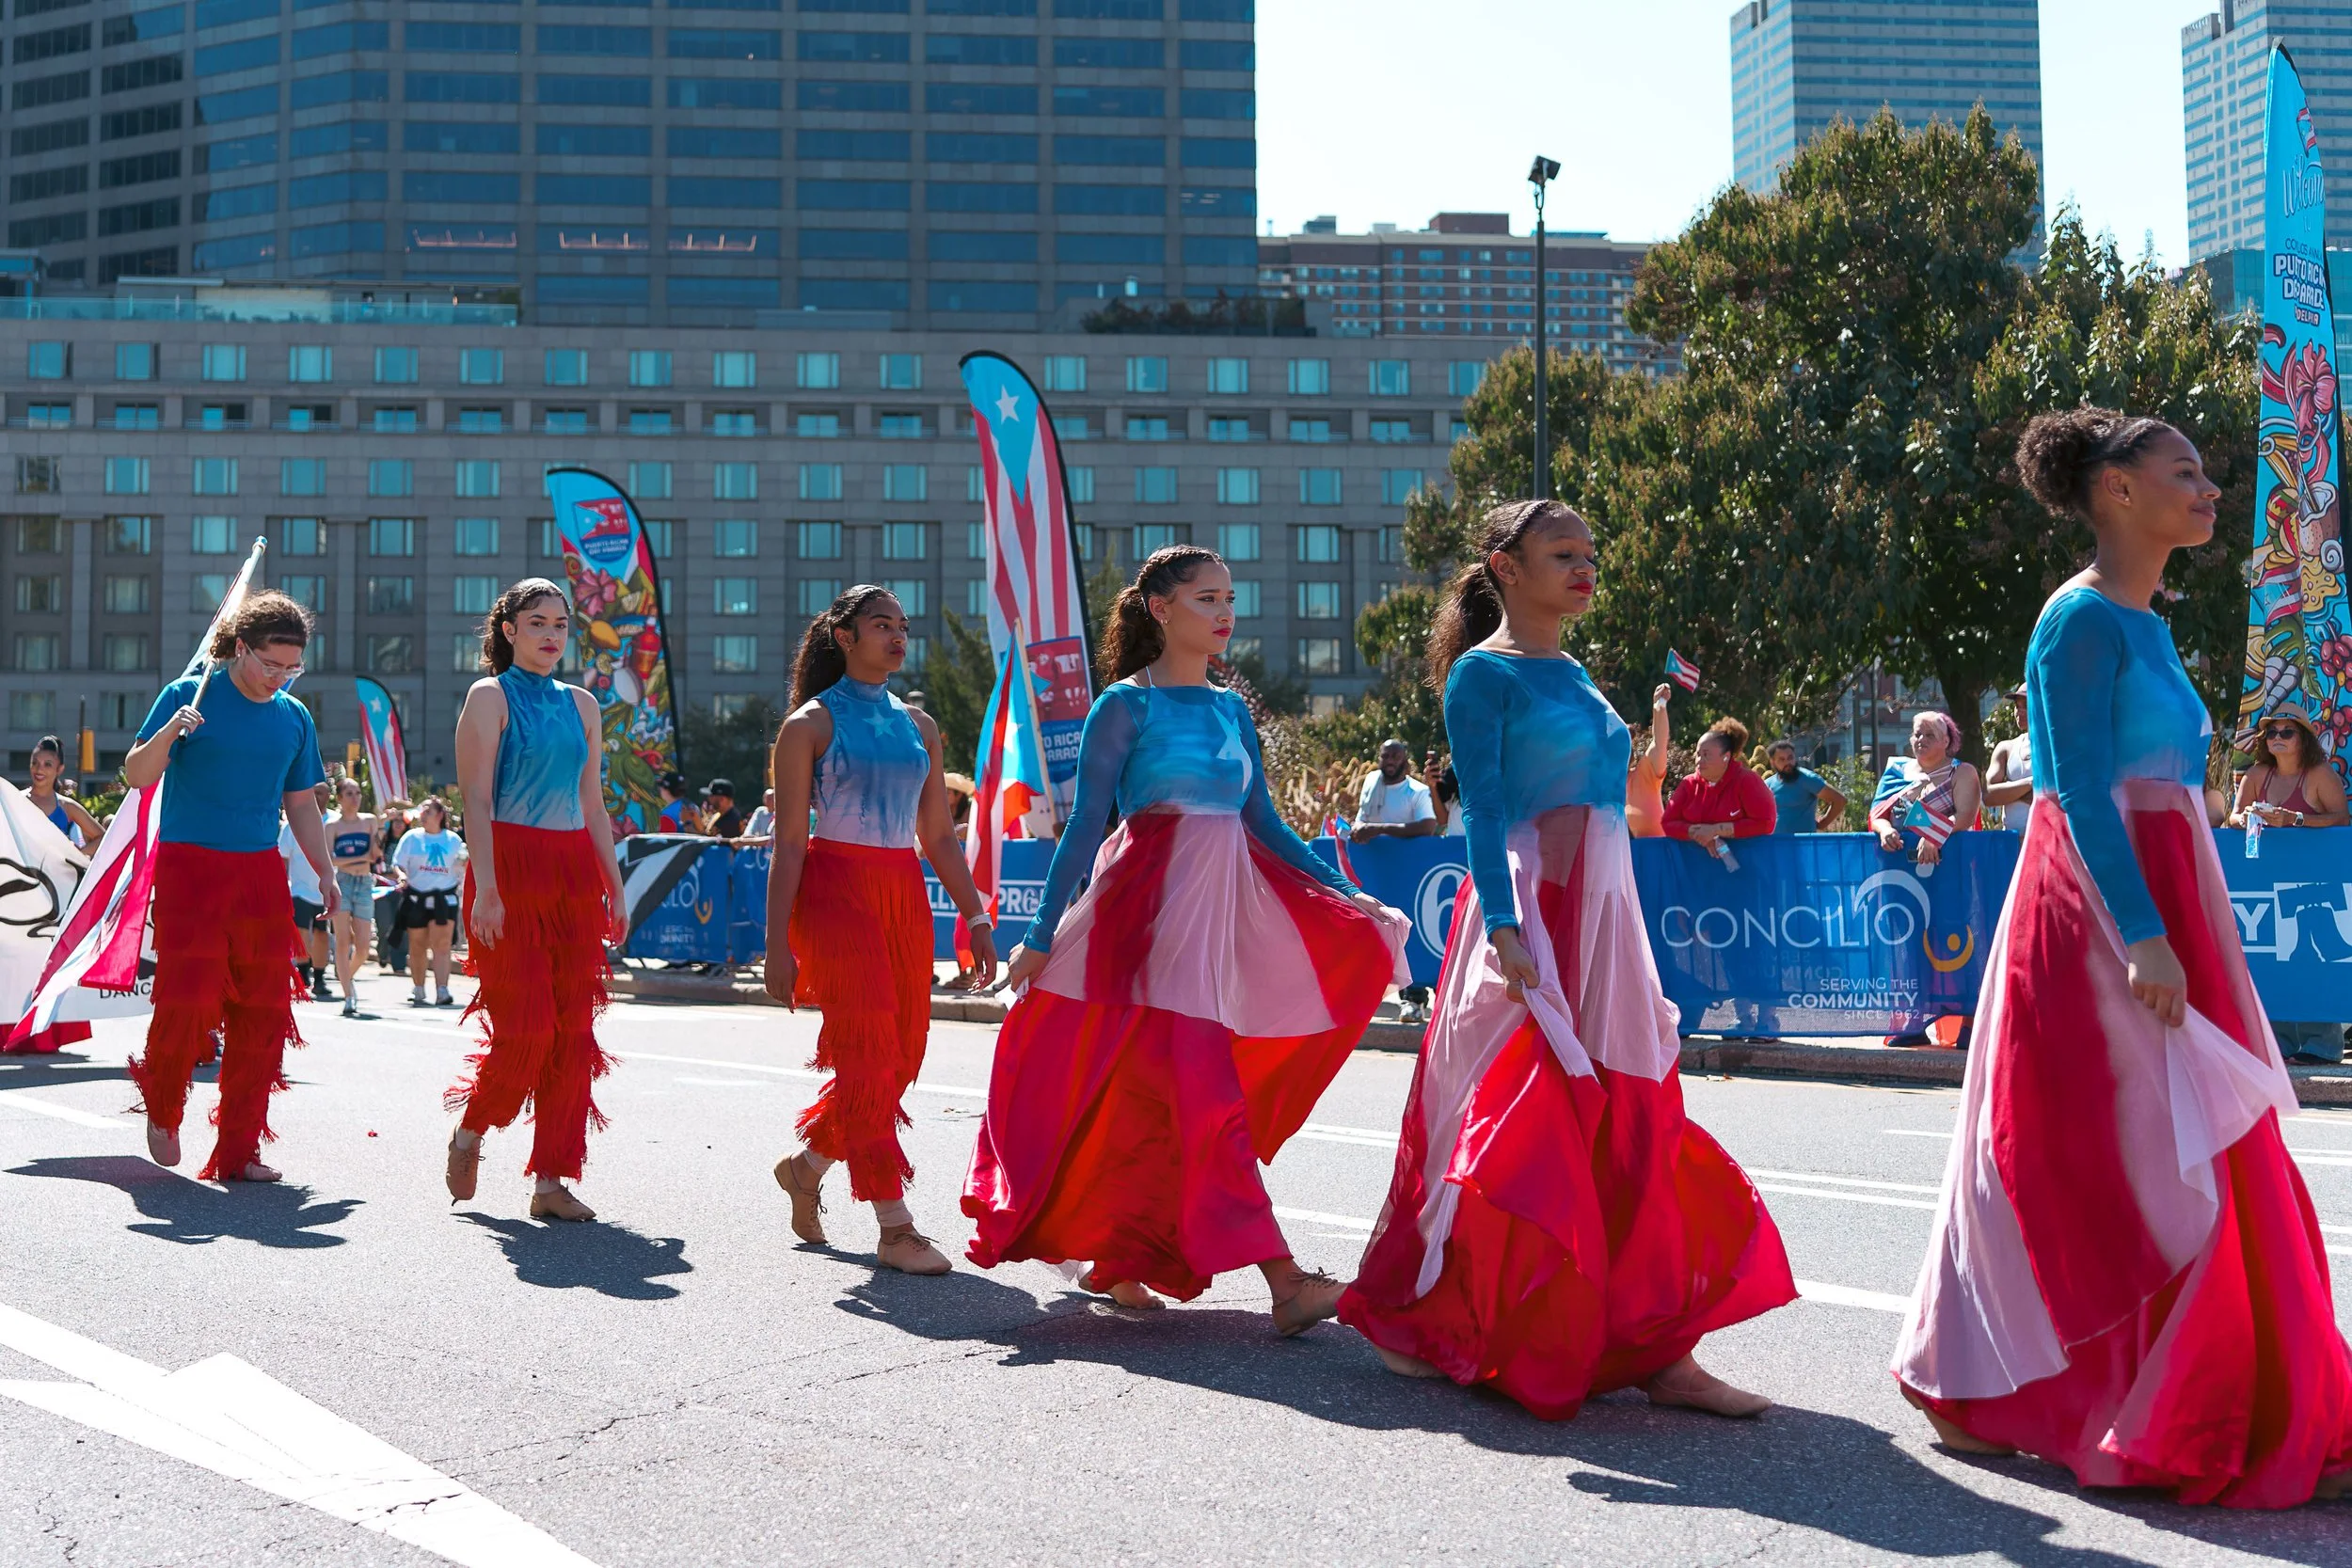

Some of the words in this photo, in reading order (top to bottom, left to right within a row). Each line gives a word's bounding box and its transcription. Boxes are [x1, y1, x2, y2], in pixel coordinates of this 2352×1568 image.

[1053, 731, 1081, 748] RICA
[1661, 903, 1915, 949] CONCILIO
[1820, 977, 1886, 991] SERVING
[1891, 978, 1918, 990] THE
[1788, 992, 1918, 1009] COMMUNITY
[1843, 1009, 1883, 1021] SINCE
[1890, 1009, 1920, 1021] 1962
